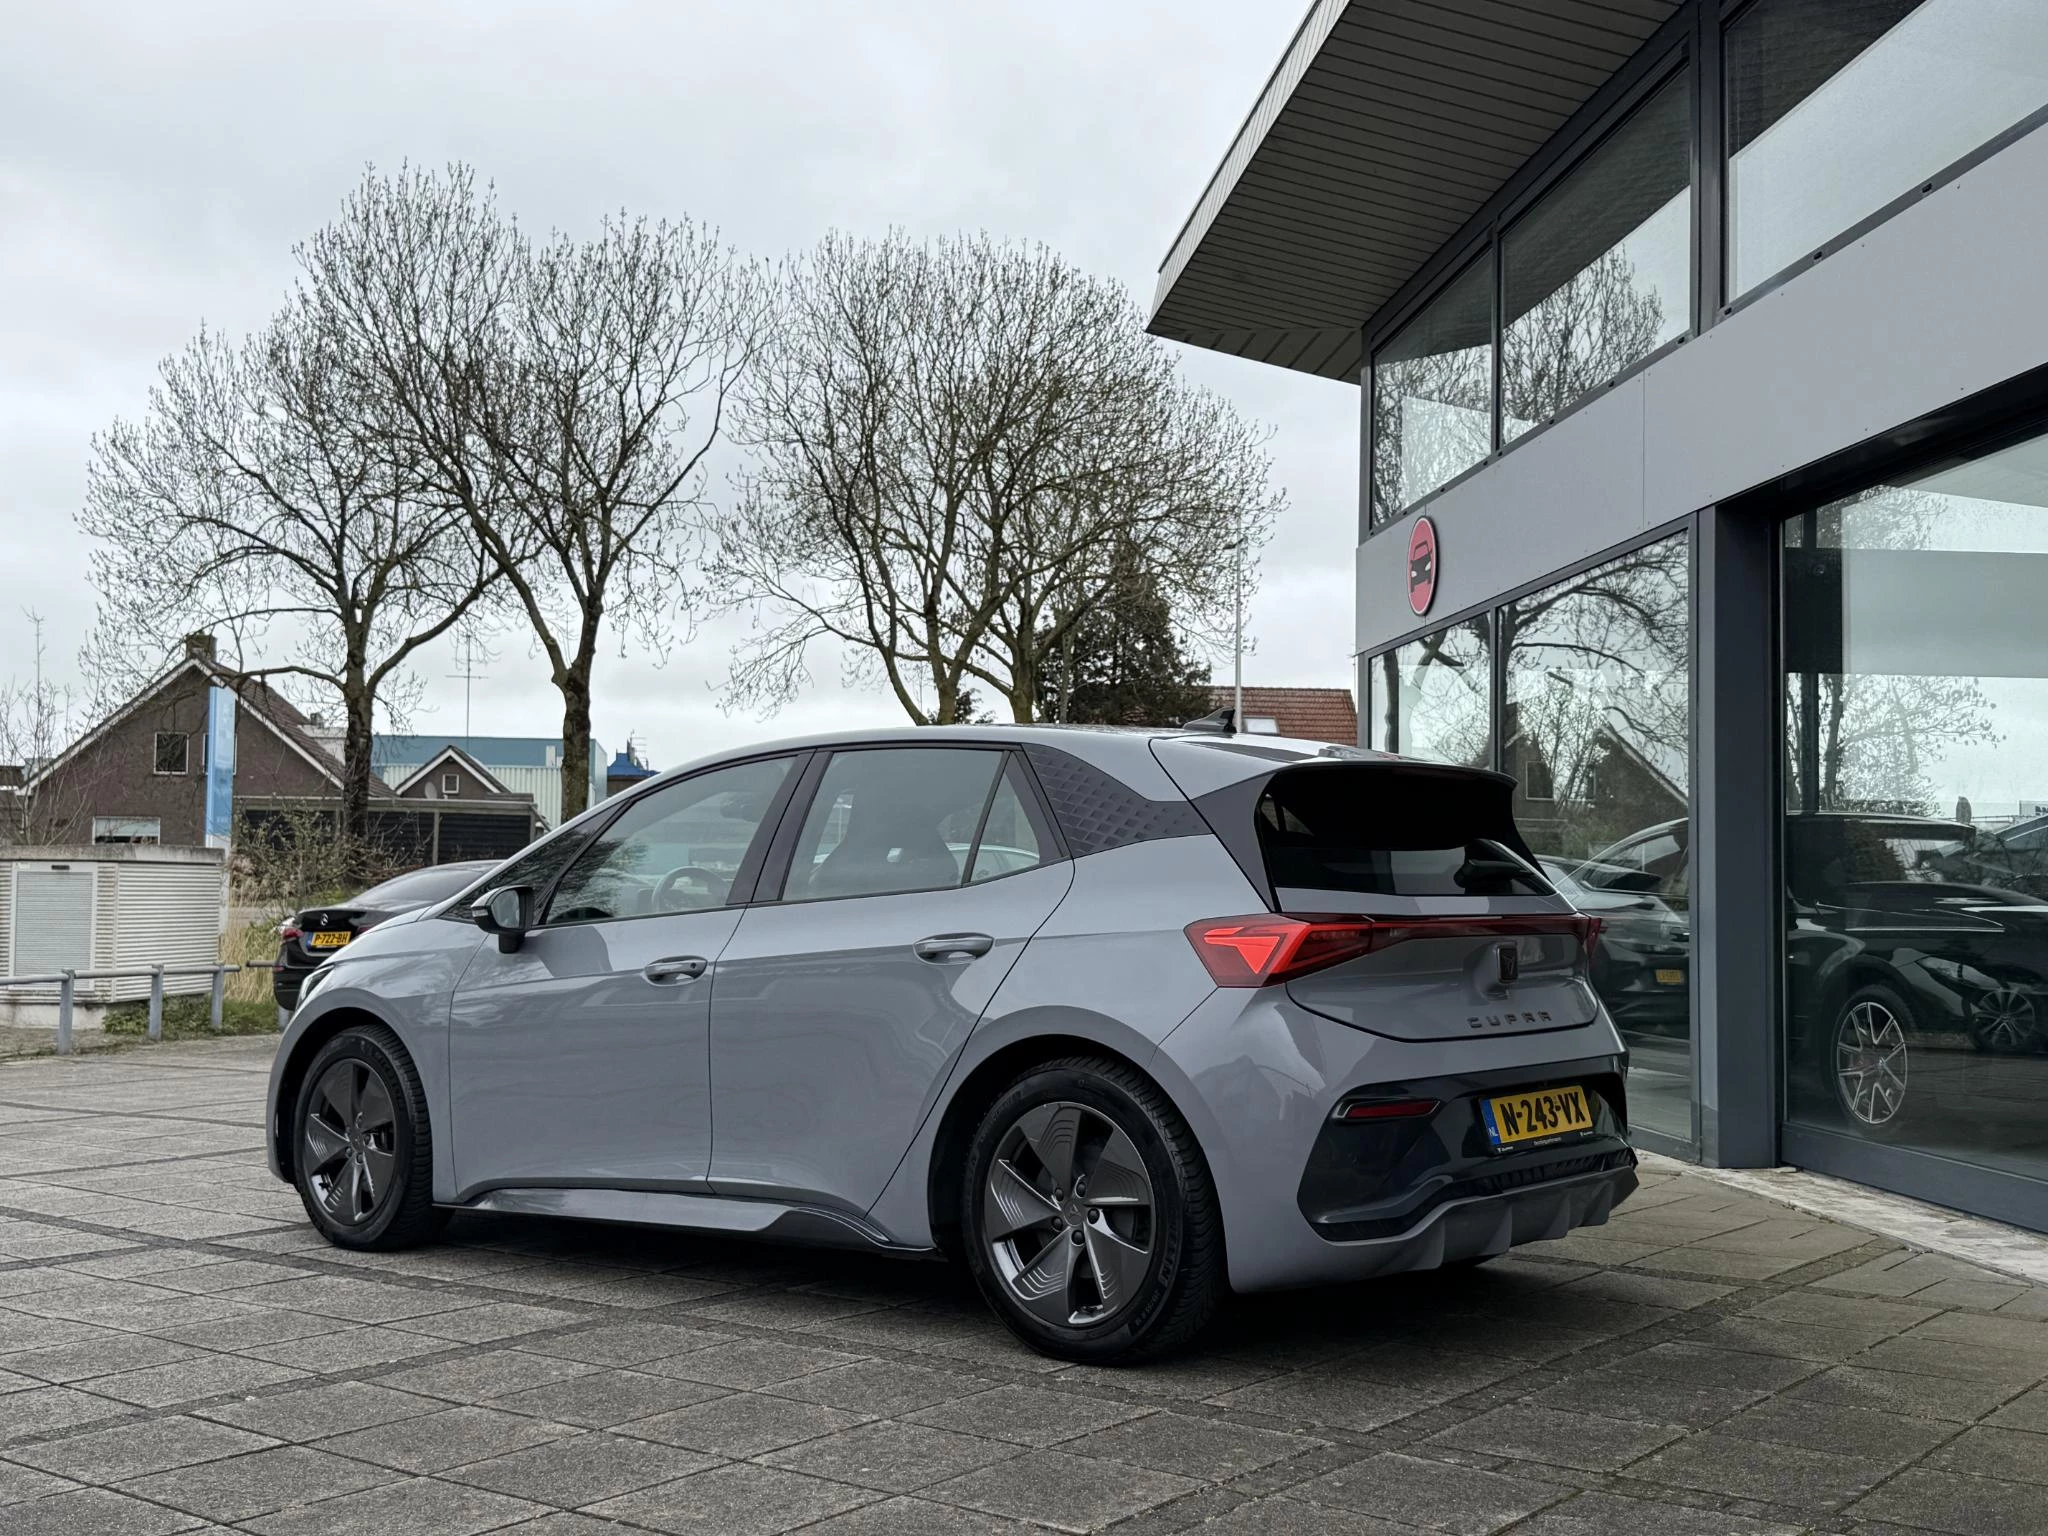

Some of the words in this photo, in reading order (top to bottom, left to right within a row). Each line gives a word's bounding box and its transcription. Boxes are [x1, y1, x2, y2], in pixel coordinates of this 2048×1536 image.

[1467, 1011, 1552, 1029] CUPRA
[1500, 1091, 1586, 1137] N-243-VX
[1488, 1127, 1499, 1138] NL
